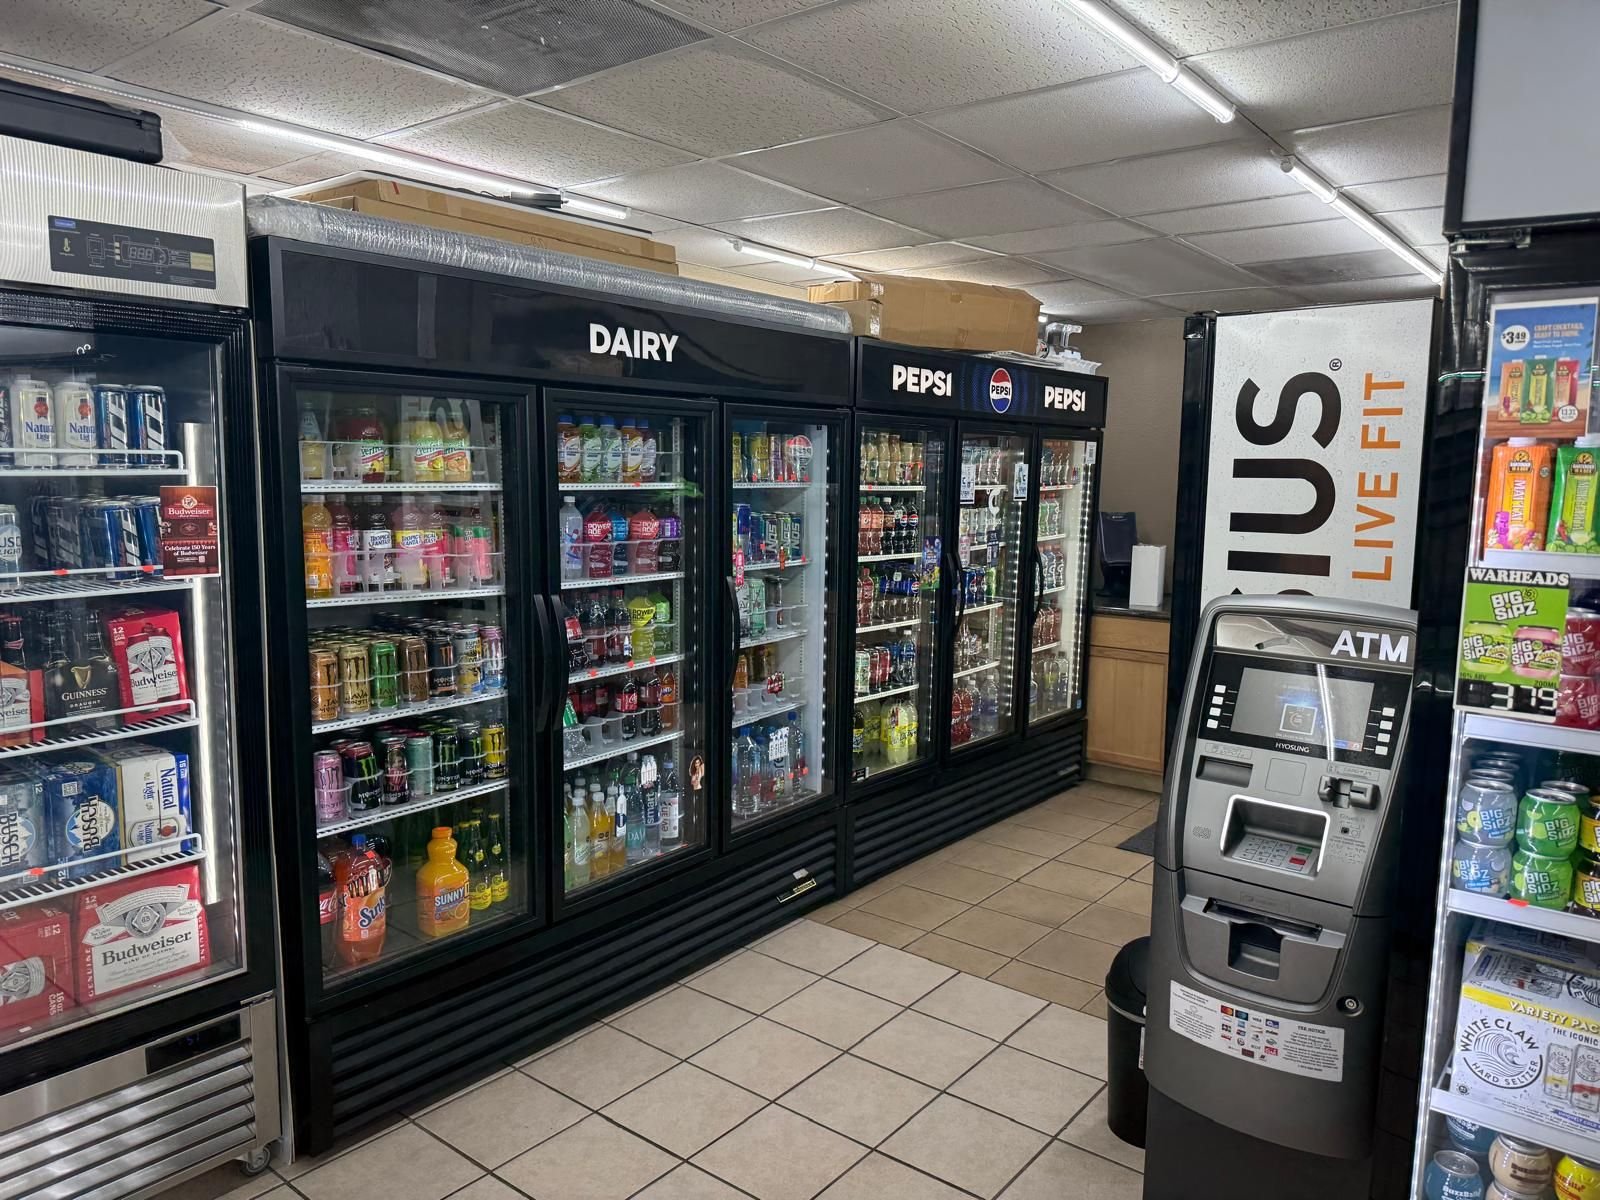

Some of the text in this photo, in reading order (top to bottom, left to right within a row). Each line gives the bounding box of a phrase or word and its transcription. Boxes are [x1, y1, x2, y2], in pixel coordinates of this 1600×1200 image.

[589, 322, 679, 362] DAIRY
[892, 364, 952, 397] PEPSI
[991, 384, 1011, 396] PEPSI
[1044, 385, 1086, 412] PEPSI
[1352, 371, 1405, 581] LIVE FIT
[168, 507, 210, 515] Budweiser
[1470, 567, 1570, 587] WARHEADS
[113, 626, 124, 634] 12
[1330, 629, 1410, 663] ATM
[61, 687, 108, 701] GUINNESS
[69, 700, 101, 708] DRAUGHT
[1275, 742, 1310, 753] HYOSUNG
[160, 767, 178, 810] Natural
[646, 791, 655, 824] smart
[52, 923, 61, 936] 12
[197, 915, 206, 960] GENUINE
[102, 931, 193, 967] Budweiser
[85, 948, 94, 997] GENUINE
[48, 993, 57, 1016] CANS
[1509, 1000, 1569, 1025] VARIETY
[1461, 1017, 1540, 1052] WHITE CLAW
[1553, 1026, 1599, 1047] THE ICONIC
[1472, 1059, 1540, 1087] HARD SELTZER
